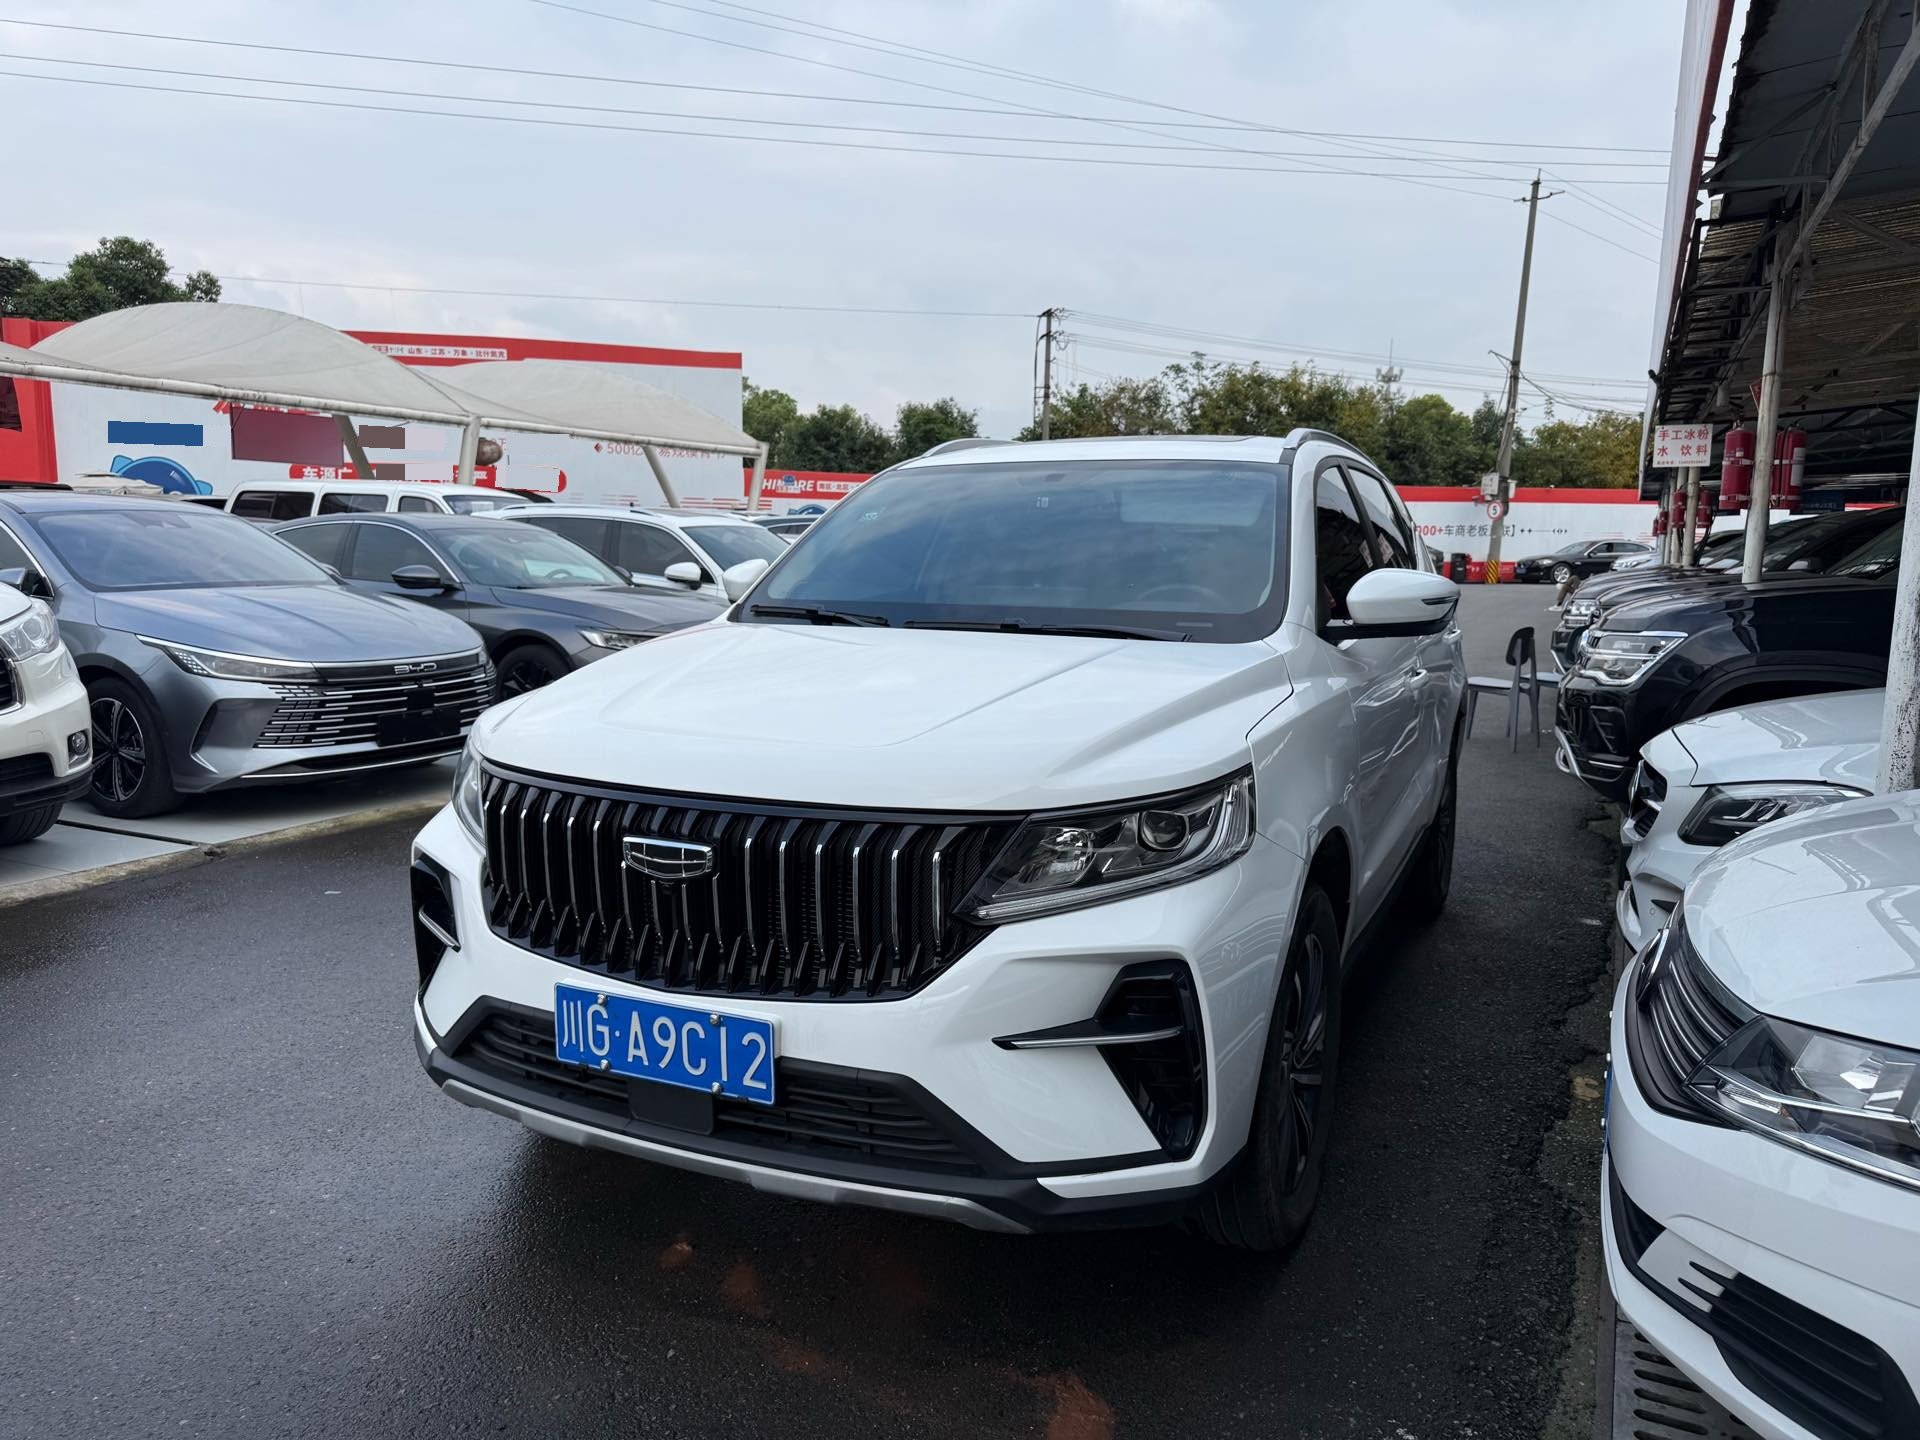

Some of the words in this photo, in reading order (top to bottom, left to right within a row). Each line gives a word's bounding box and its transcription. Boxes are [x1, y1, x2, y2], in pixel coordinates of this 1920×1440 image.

[1657, 429, 1709, 441] 手工冰粉
[1657, 445, 1669, 457] 水
[1680, 444, 1708, 456] 饮料
[1492, 503, 1498, 516] 5
[393, 662, 437, 675] BYD
